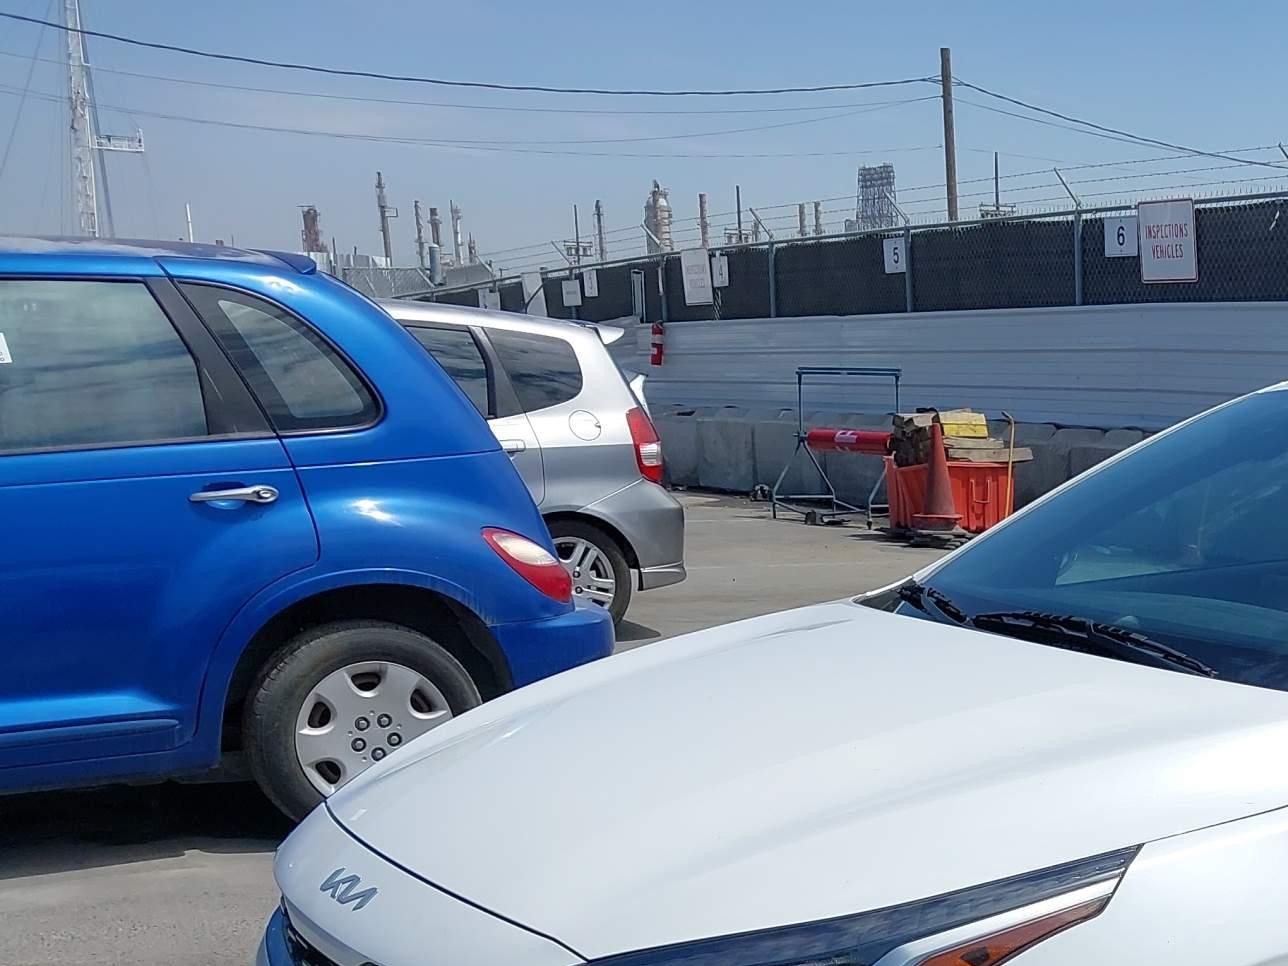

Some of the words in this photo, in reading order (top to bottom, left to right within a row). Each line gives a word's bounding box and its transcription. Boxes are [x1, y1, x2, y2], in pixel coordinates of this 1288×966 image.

[1116, 226, 1126, 246] 6
[1144, 223, 1188, 240] INSPECTIONS
[893, 247, 900, 264] 5
[1151, 244, 1184, 259] VEHICLES
[320, 867, 378, 911] KIA
